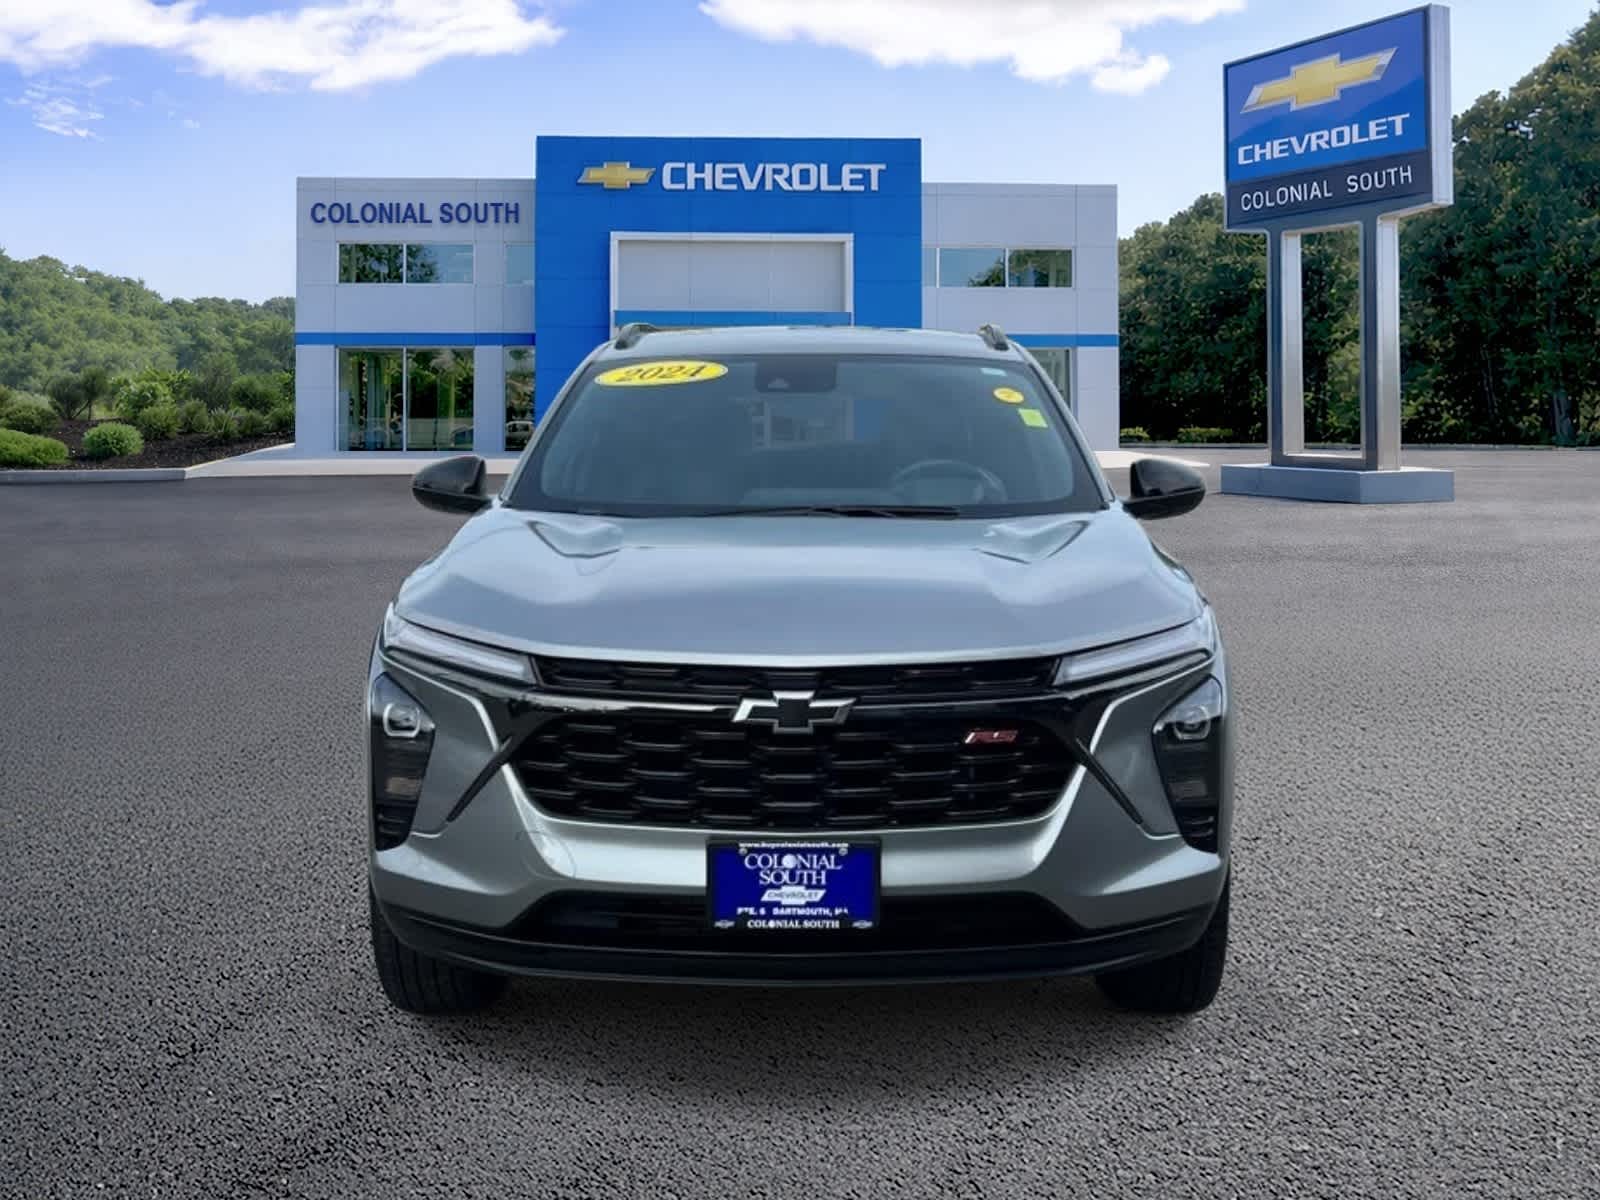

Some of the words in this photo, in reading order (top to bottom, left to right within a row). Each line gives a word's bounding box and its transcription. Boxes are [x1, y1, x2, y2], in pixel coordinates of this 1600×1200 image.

[1237, 112, 1411, 165] CHEVROLET
[661, 161, 887, 192] CHEVROLET
[1240, 178, 1333, 211] COLONIAL
[1346, 165, 1413, 193] SOUTH
[310, 202, 433, 224] COLONIAL
[439, 202, 520, 224] SOUTH
[616, 365, 708, 383] 2024
[744, 853, 843, 870] COLONIAL
[759, 870, 827, 885] SOUTH
[747, 920, 801, 929] COLONIAL
[803, 920, 840, 929] SOUTH
